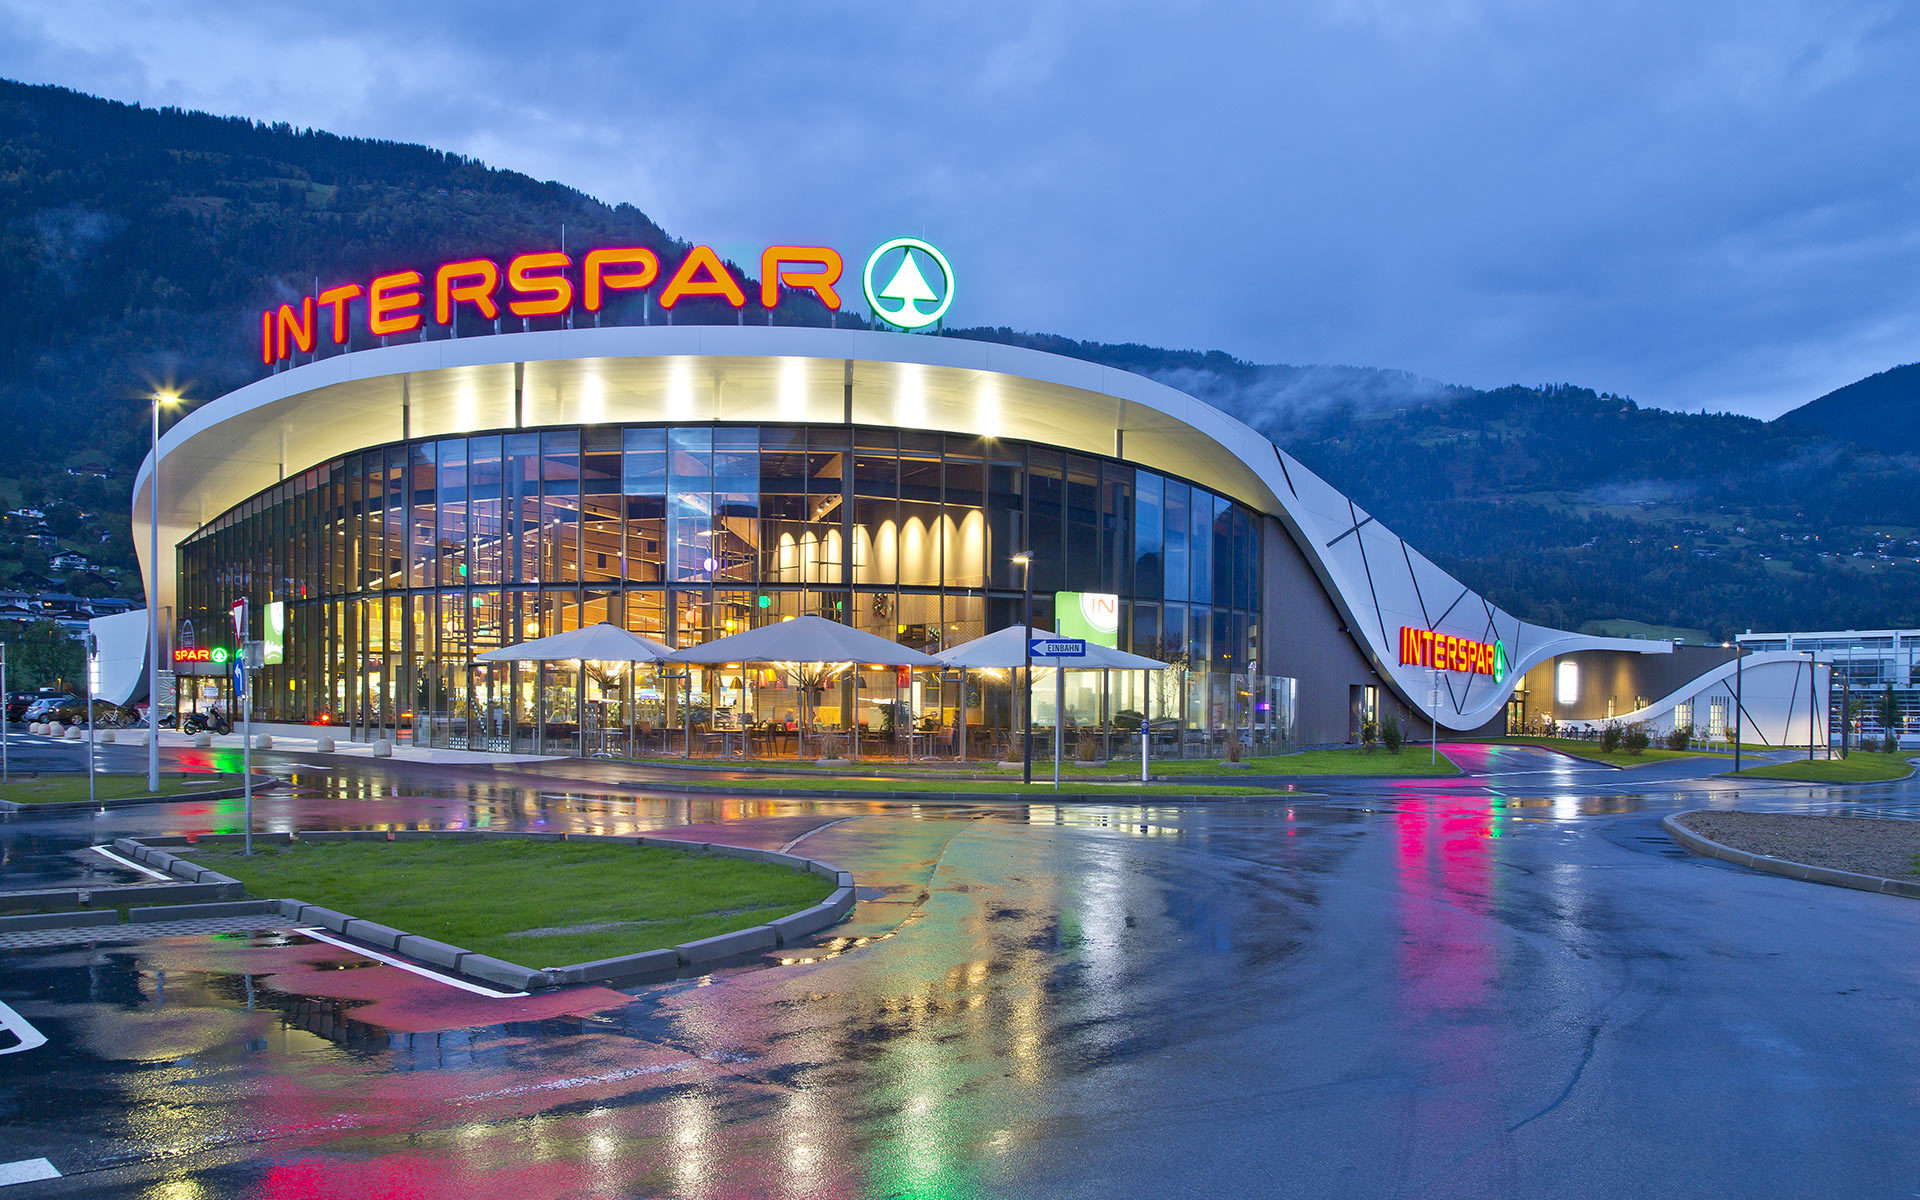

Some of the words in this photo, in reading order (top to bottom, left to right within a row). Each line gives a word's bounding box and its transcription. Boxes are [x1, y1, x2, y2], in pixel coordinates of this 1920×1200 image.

[263, 245, 844, 365] INTERSPAR
[1092, 598, 1115, 614] IN
[174, 649, 210, 661] SPAR
[1047, 643, 1080, 652] EINBAHN
[1401, 626, 1495, 676] INTERSPAR
